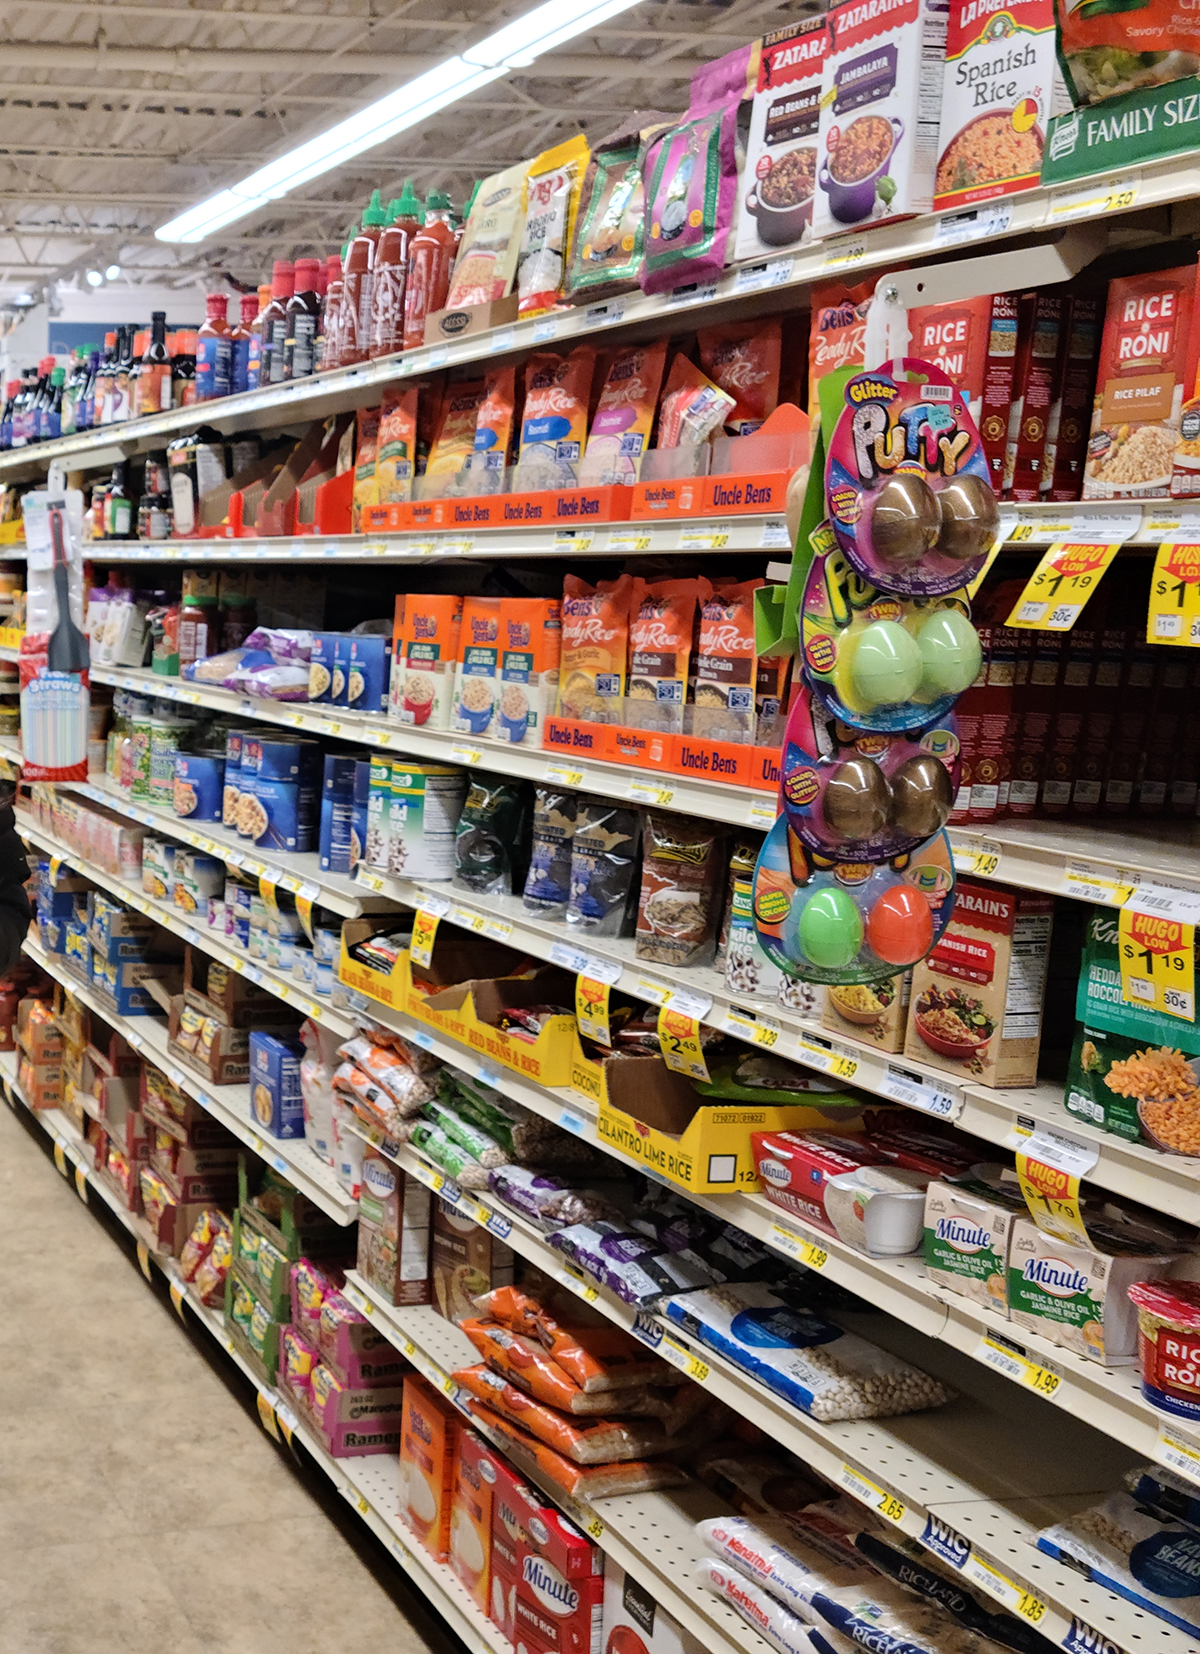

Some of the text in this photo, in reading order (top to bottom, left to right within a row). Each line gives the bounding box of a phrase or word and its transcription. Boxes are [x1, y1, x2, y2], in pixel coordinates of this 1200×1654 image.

[960, 2, 978, 28] LA
[765, 18, 821, 46] FAMILY SIZE
[1126, 27, 1164, 38] Savory
[840, 57, 888, 84] JAMBALAYA
[955, 43, 1036, 88] Spanish
[972, 80, 1017, 108] Rice
[1032, 85, 1042, 99] 15
[785, 97, 809, 116] BEANS
[1087, 104, 1158, 147] FAMILY
[994, 296, 1018, 307] RICE
[1038, 297, 1062, 308] RICE
[1123, 294, 1174, 323] RICE
[992, 307, 1017, 318] RONI
[924, 320, 967, 347] RICE
[1119, 331, 1170, 359] RONI
[926, 354, 963, 375] ONI
[850, 384, 898, 403] Glitter
[1114, 386, 1161, 400] RICE PILAF
[852, 402, 971, 480] PUTTY
[645, 488, 661, 502] Uncle
[713, 484, 743, 506] Uncle
[455, 507, 473, 522] Uncle
[504, 504, 520, 520] Uncle
[557, 499, 579, 517] Uncle
[1061, 544, 1103, 562] HUGO
[1061, 561, 1086, 572] LOW
[869, 602, 900, 615] TWIN
[413, 614, 428, 627] Uncle
[471, 616, 488, 631] Uncle
[507, 620, 522, 635] Uncle
[641, 654, 662, 667] Grain
[709, 658, 734, 672] Grain
[29, 679, 81, 694] Straws
[550, 724, 571, 745] Uncle
[615, 733, 631, 746] Uncle
[855, 736, 890, 749] TWIN
[681, 747, 709, 770] Uncle
[786, 769, 813, 786] LOADED
[792, 779, 812, 792] WITH
[974, 854, 999, 874] 1.49
[758, 899, 787, 910] BRIGHT
[761, 891, 784, 903] SUPER
[731, 928, 757, 945] wild
[1135, 915, 1179, 941] HUGO
[937, 938, 988, 959] PANISH RICE
[1144, 936, 1170, 951] LOW
[1163, 993, 1188, 1010] 30¢
[469, 1028, 541, 1077] RED BEANS & RICE
[836, 1059, 858, 1078] 1.59
[930, 1097, 952, 1115] 1.59
[714, 1113, 737, 1123] 71072
[598, 1116, 693, 1182] CILANTRO LIME RICE
[777, 1131, 820, 1153] WHITE
[819, 1149, 861, 1168] RICE
[759, 1161, 792, 1182] Minute
[1028, 1161, 1066, 1191] HUGO
[1036, 1179, 1058, 1196] LOW
[766, 1184, 822, 1220] WHITE RICE
[935, 1217, 992, 1249] Minute
[808, 1246, 828, 1268] 1.99
[933, 1248, 993, 1269] GARLIC OLIVE OIL
[943, 1258, 985, 1275] JASMINE RICE
[1023, 1258, 1089, 1292] Minute
[1019, 1290, 1044, 1304] GARLIC
[1054, 1298, 1076, 1312] OLIVE
[1077, 1304, 1090, 1316] OIL
[1031, 1300, 1081, 1321] JASMINE RICE
[638, 1313, 664, 1340] WIC
[1033, 1369, 1060, 1394] 1.99
[877, 1492, 905, 1522] 2.65
[929, 1515, 969, 1556] WIC
[925, 1533, 963, 1564] Approved
[522, 1554, 580, 1610] Minute
[898, 1563, 967, 1613] RICELAND
[725, 1579, 770, 1628] Mahatma
[1018, 1595, 1045, 1623] 1.85
[516, 1603, 558, 1641] WHITE RICE
[1075, 1617, 1120, 1654] WIC
